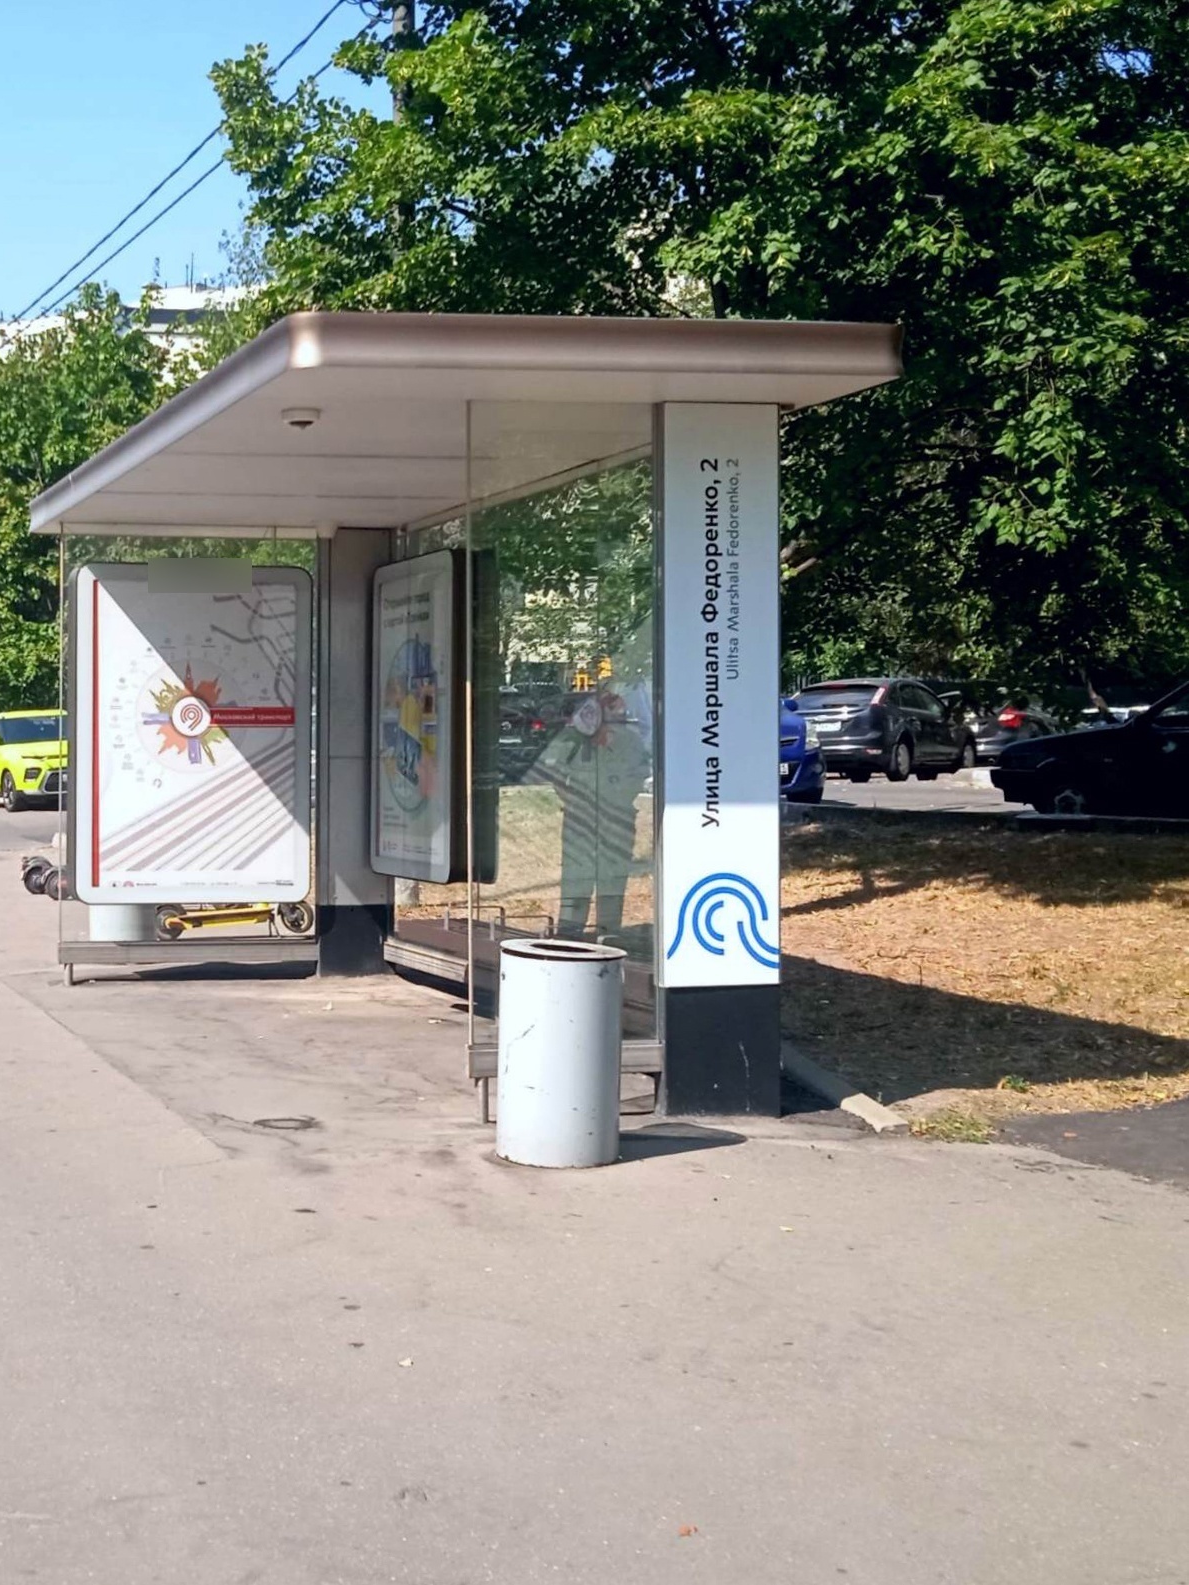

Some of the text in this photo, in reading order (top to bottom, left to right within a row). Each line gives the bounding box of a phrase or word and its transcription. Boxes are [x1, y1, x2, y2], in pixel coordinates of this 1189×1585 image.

[699, 458, 724, 828] Улица Маршала Федоренко, 2
[725, 457, 741, 680] Ulitsa Marshala Fedorenko, 2
